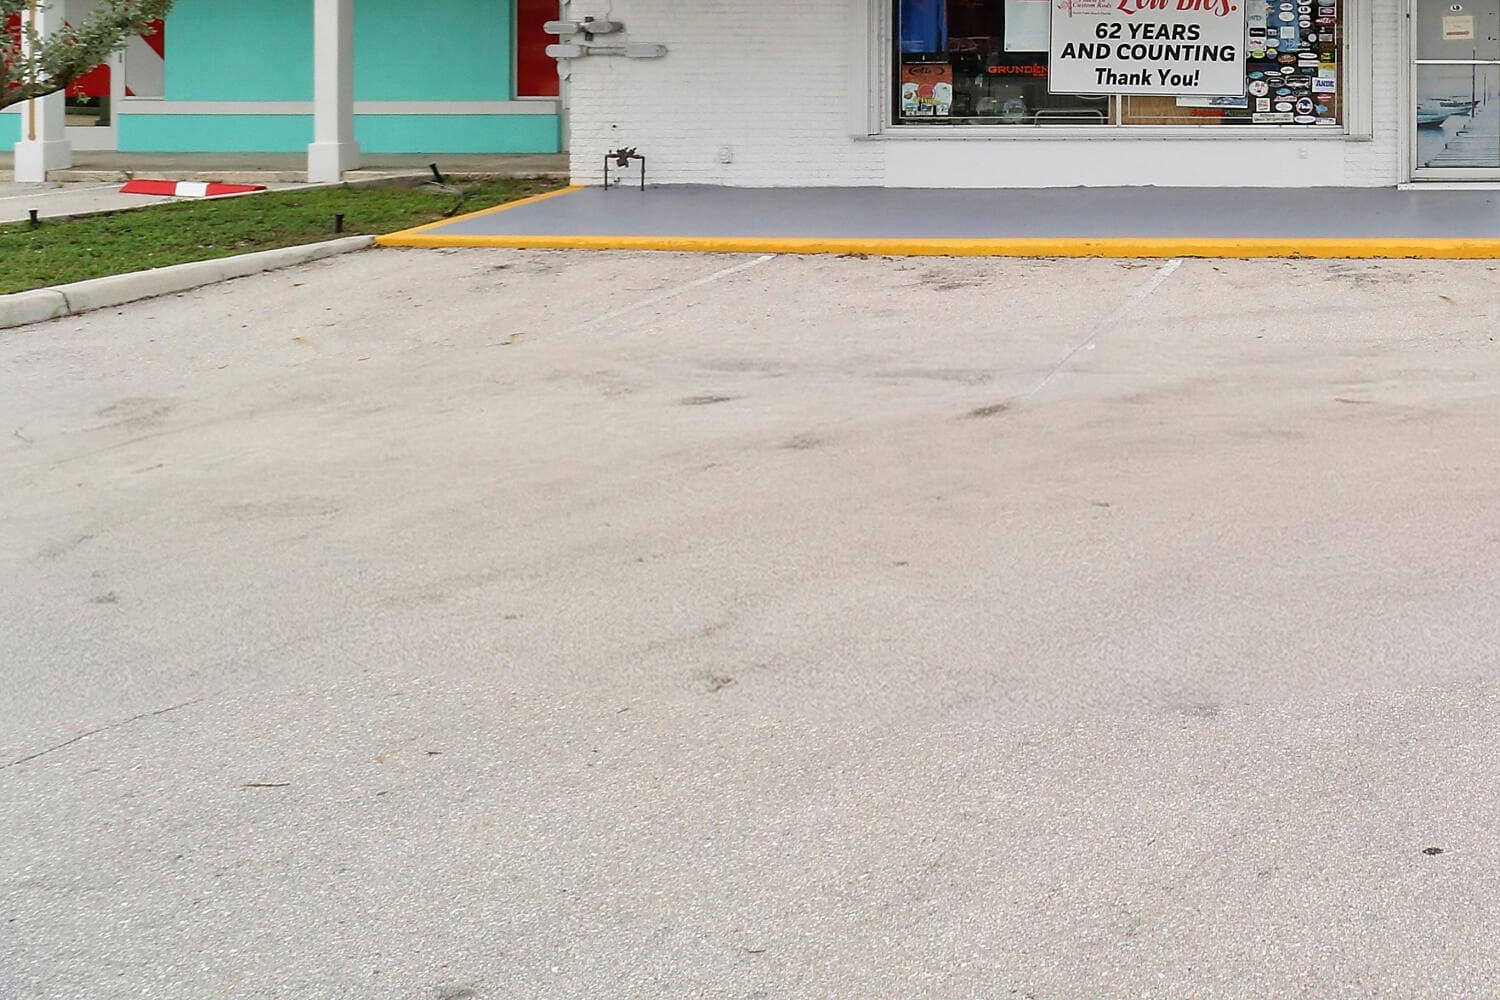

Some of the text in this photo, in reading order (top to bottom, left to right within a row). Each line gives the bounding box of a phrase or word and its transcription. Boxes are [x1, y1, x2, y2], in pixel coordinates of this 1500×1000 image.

[1095, 22, 1201, 41] 62 YEARS
[1060, 42, 1236, 62] AND COUNTING
[1095, 67, 1201, 87] Thank You!
